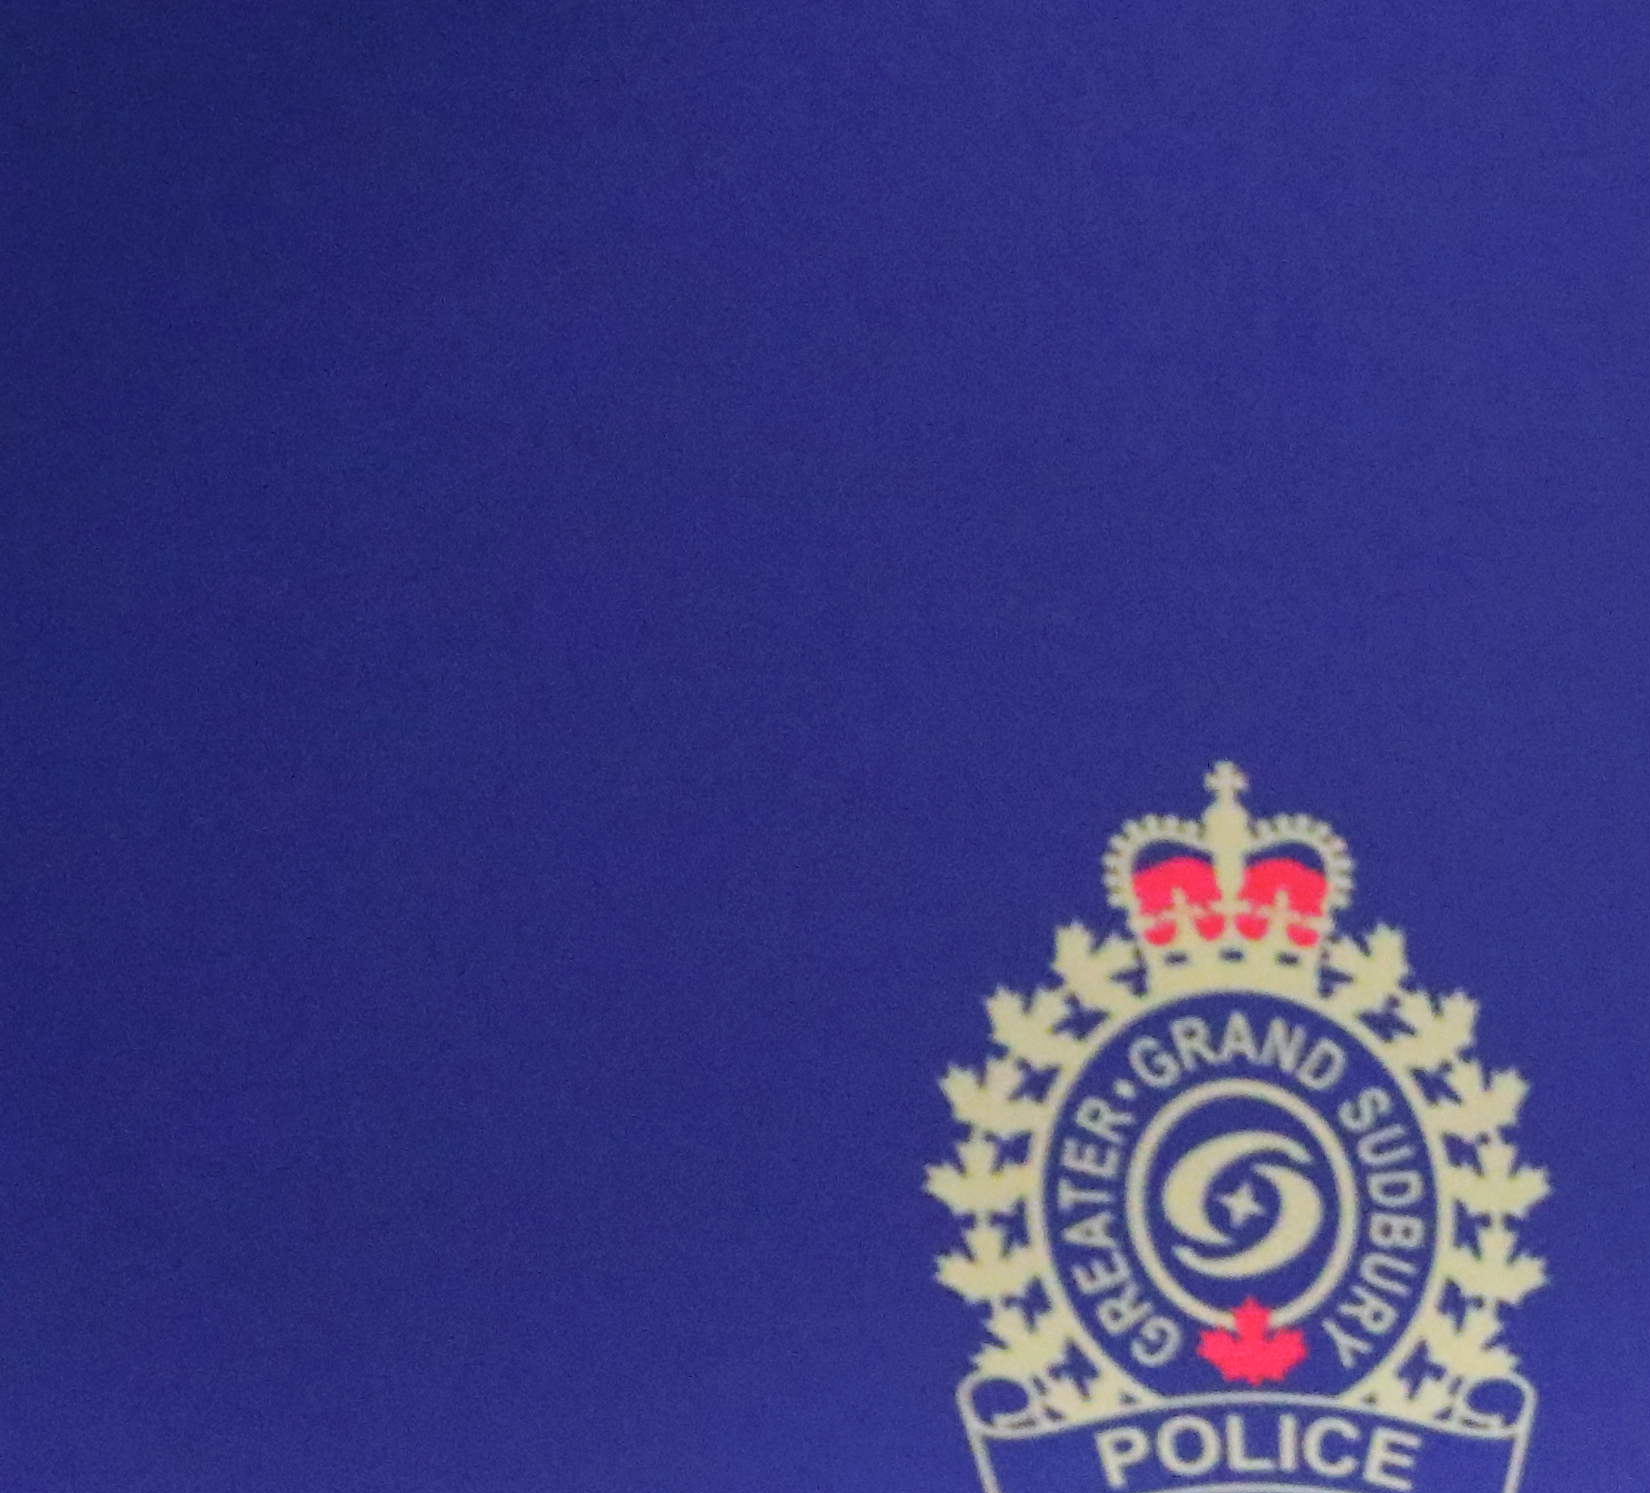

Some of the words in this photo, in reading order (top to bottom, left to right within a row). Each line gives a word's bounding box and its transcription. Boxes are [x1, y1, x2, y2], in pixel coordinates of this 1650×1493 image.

[1058, 1096, 1181, 1367] GREATER
[1128, 1011, 1347, 1090] GRAND
[1322, 1086, 1424, 1367] SUDBURY
[1094, 1414, 1422, 1490] POLICE
